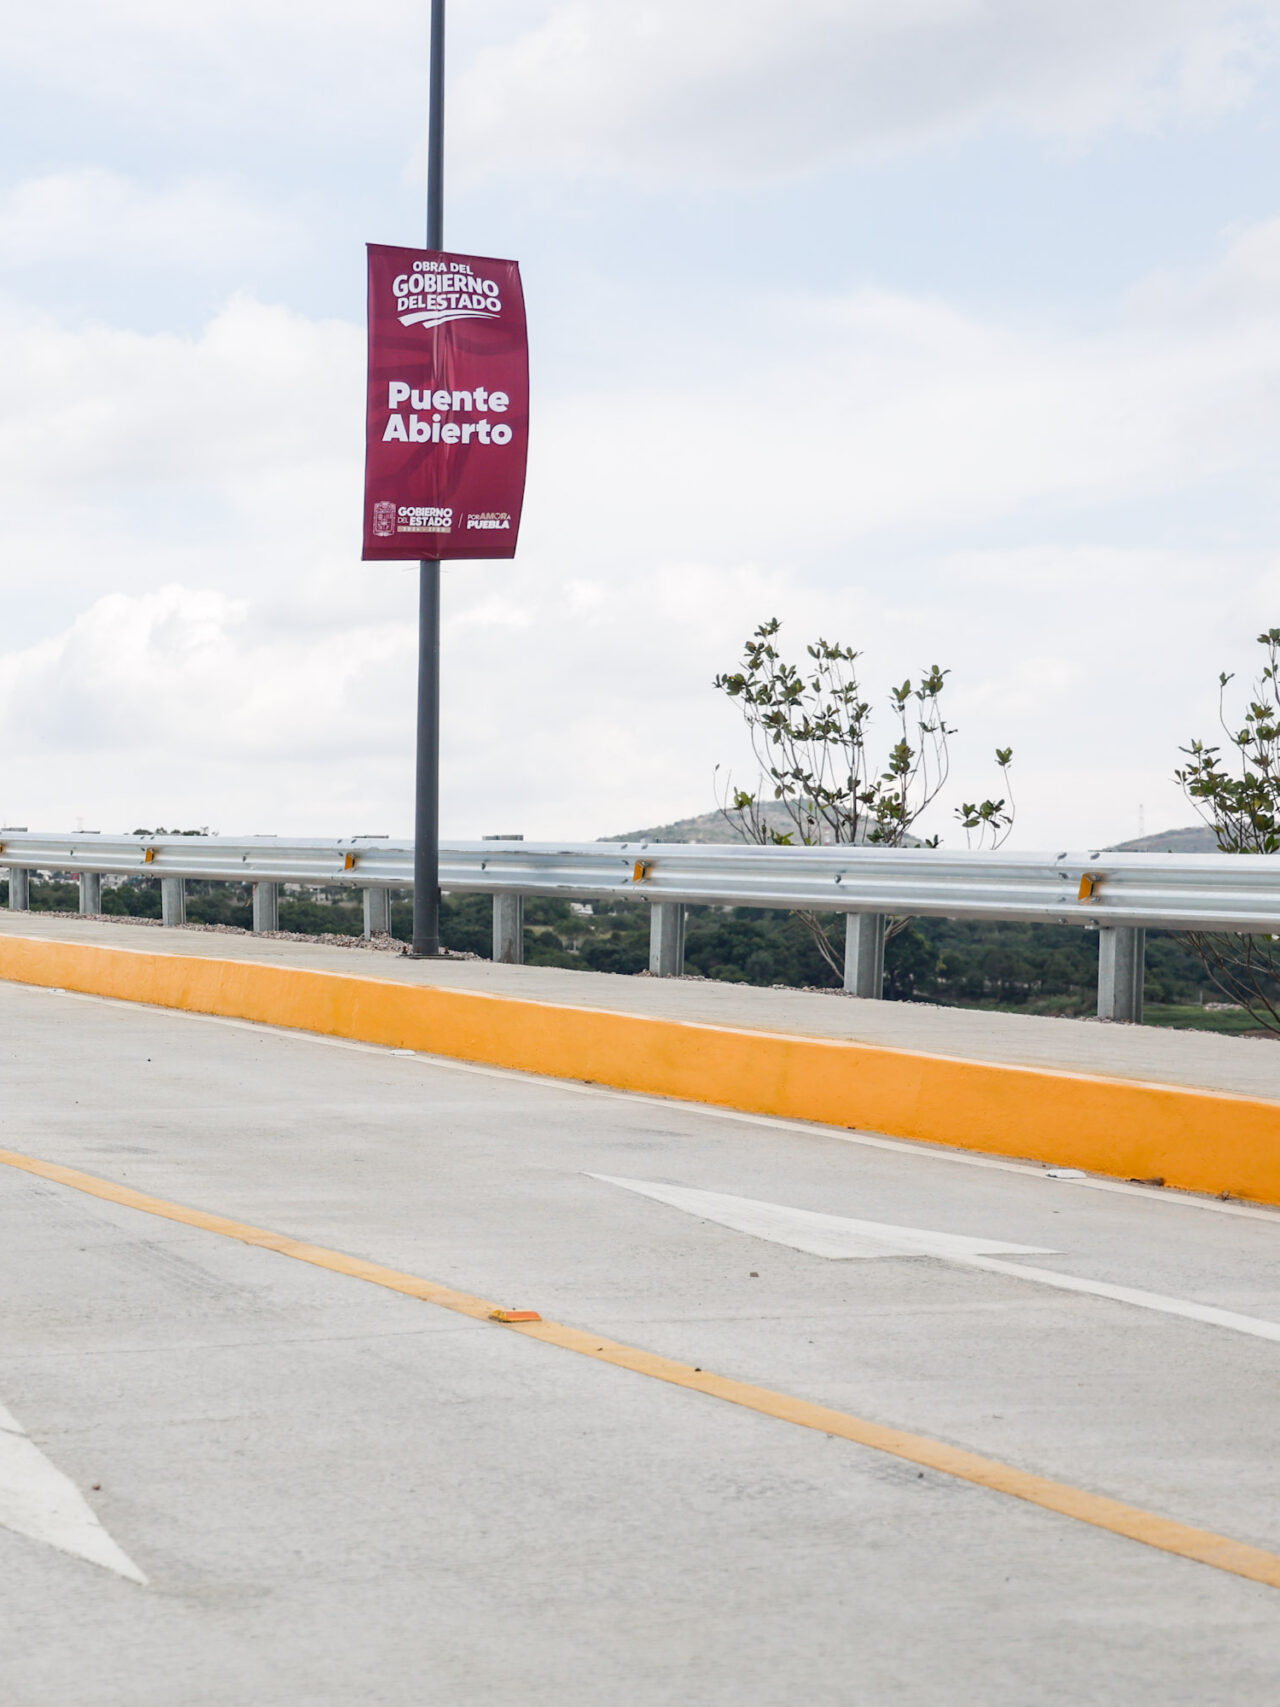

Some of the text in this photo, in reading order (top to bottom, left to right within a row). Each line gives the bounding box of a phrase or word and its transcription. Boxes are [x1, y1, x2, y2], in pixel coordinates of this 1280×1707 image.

[413, 261, 474, 275] OBRA DEL
[392, 273, 500, 298] GOBIERNO
[397, 293, 502, 312] DEL ESTADO
[388, 381, 510, 413] Puente
[381, 413, 513, 446] Abierto
[397, 506, 453, 518] GOBIERNO
[409, 517, 452, 527] ESTADO
[466, 519, 510, 529] PUEBLA
